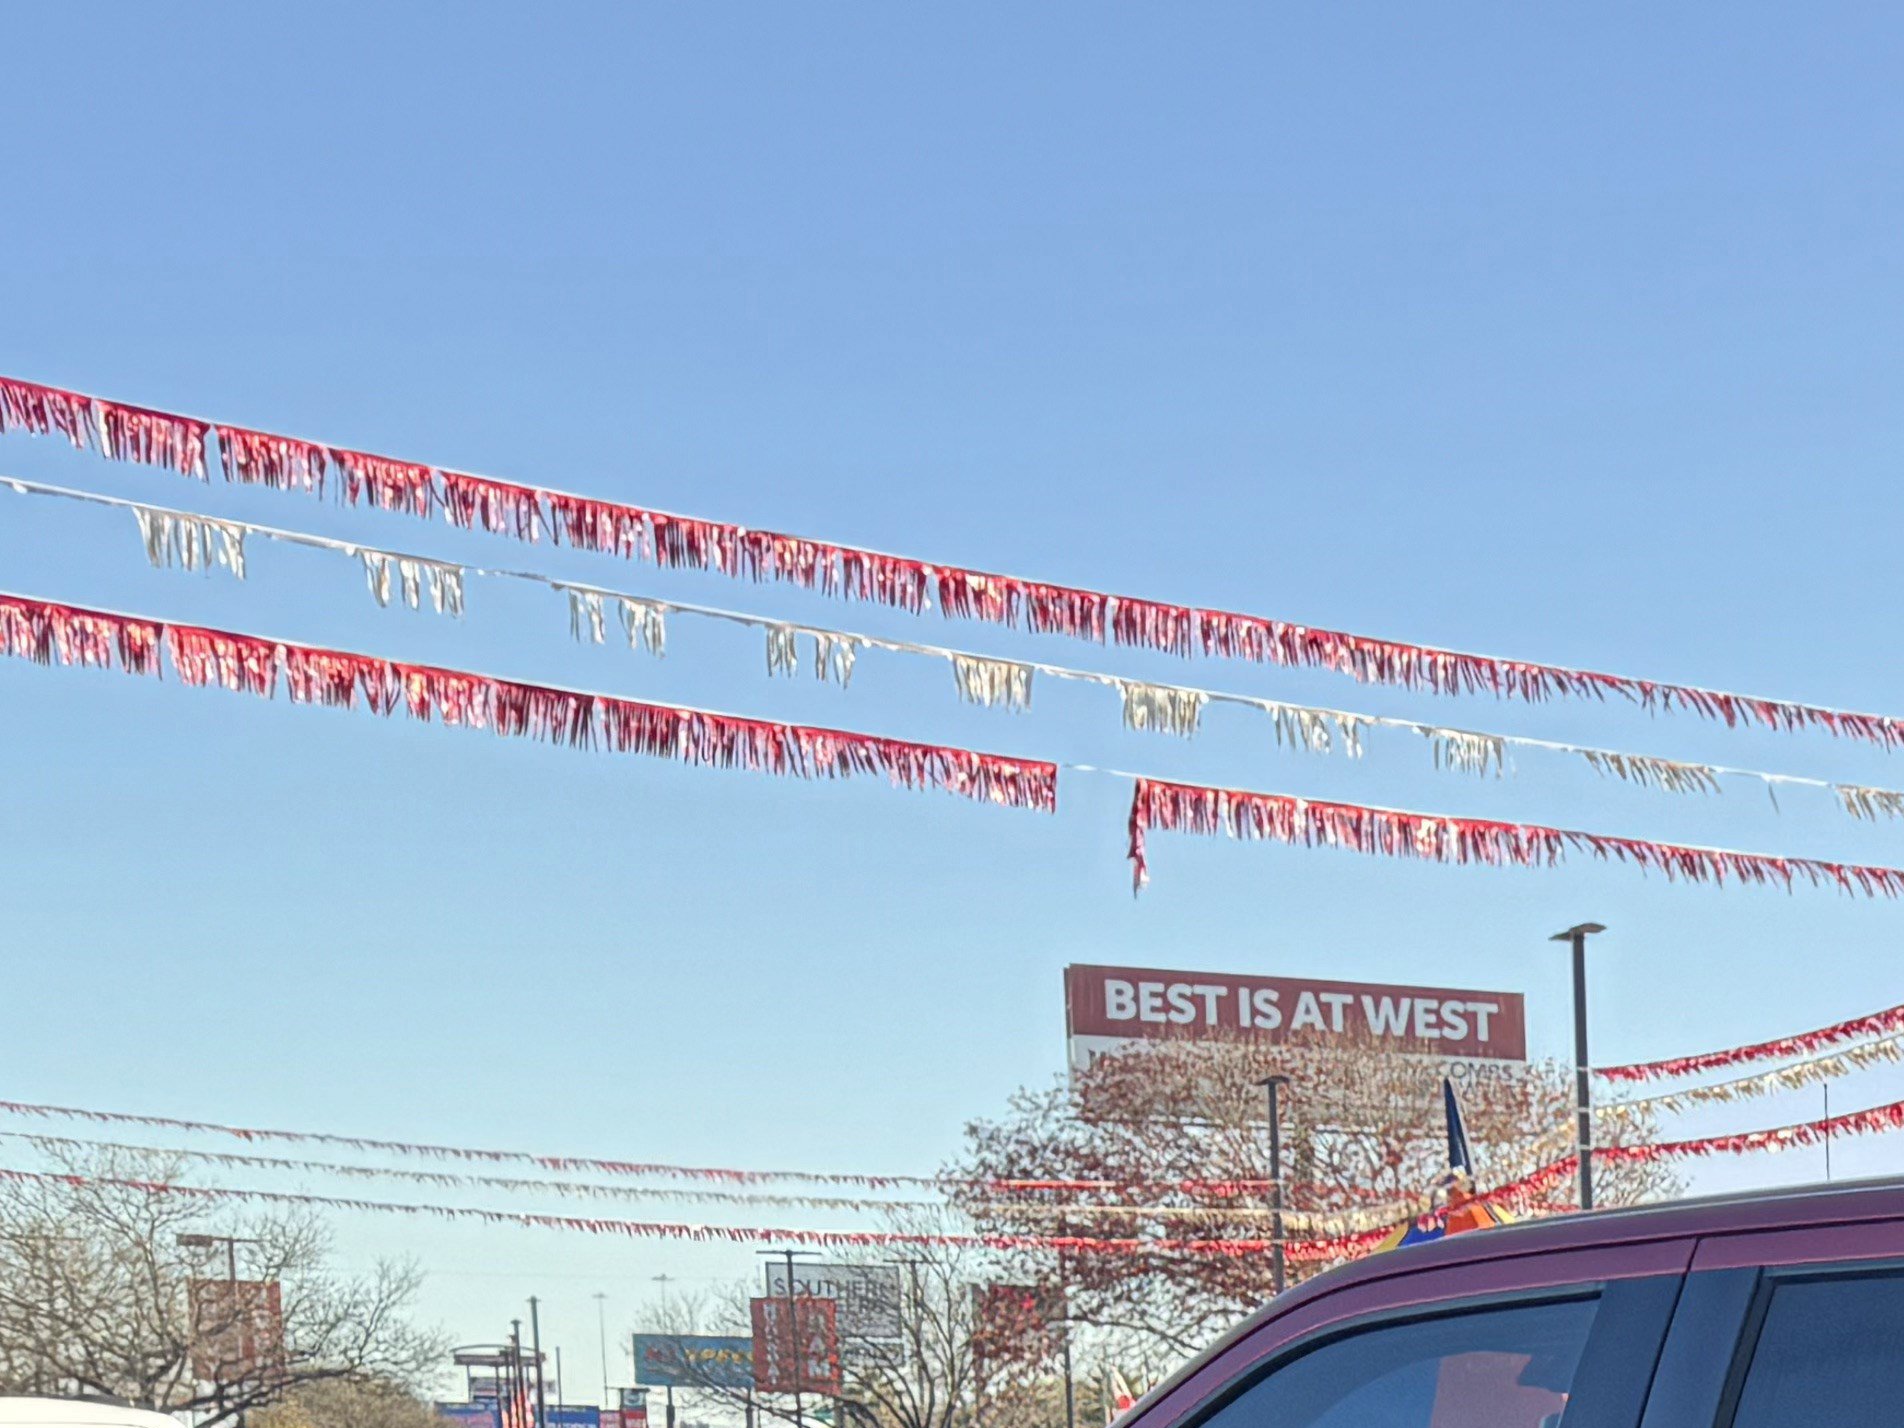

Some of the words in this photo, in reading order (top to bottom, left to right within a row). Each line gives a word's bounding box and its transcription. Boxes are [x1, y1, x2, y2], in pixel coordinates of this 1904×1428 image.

[1104, 979, 1228, 1026] BEST
[1238, 987, 1282, 1030] IS
[1291, 991, 1353, 1034] AT
[1362, 997, 1499, 1042] WEST
